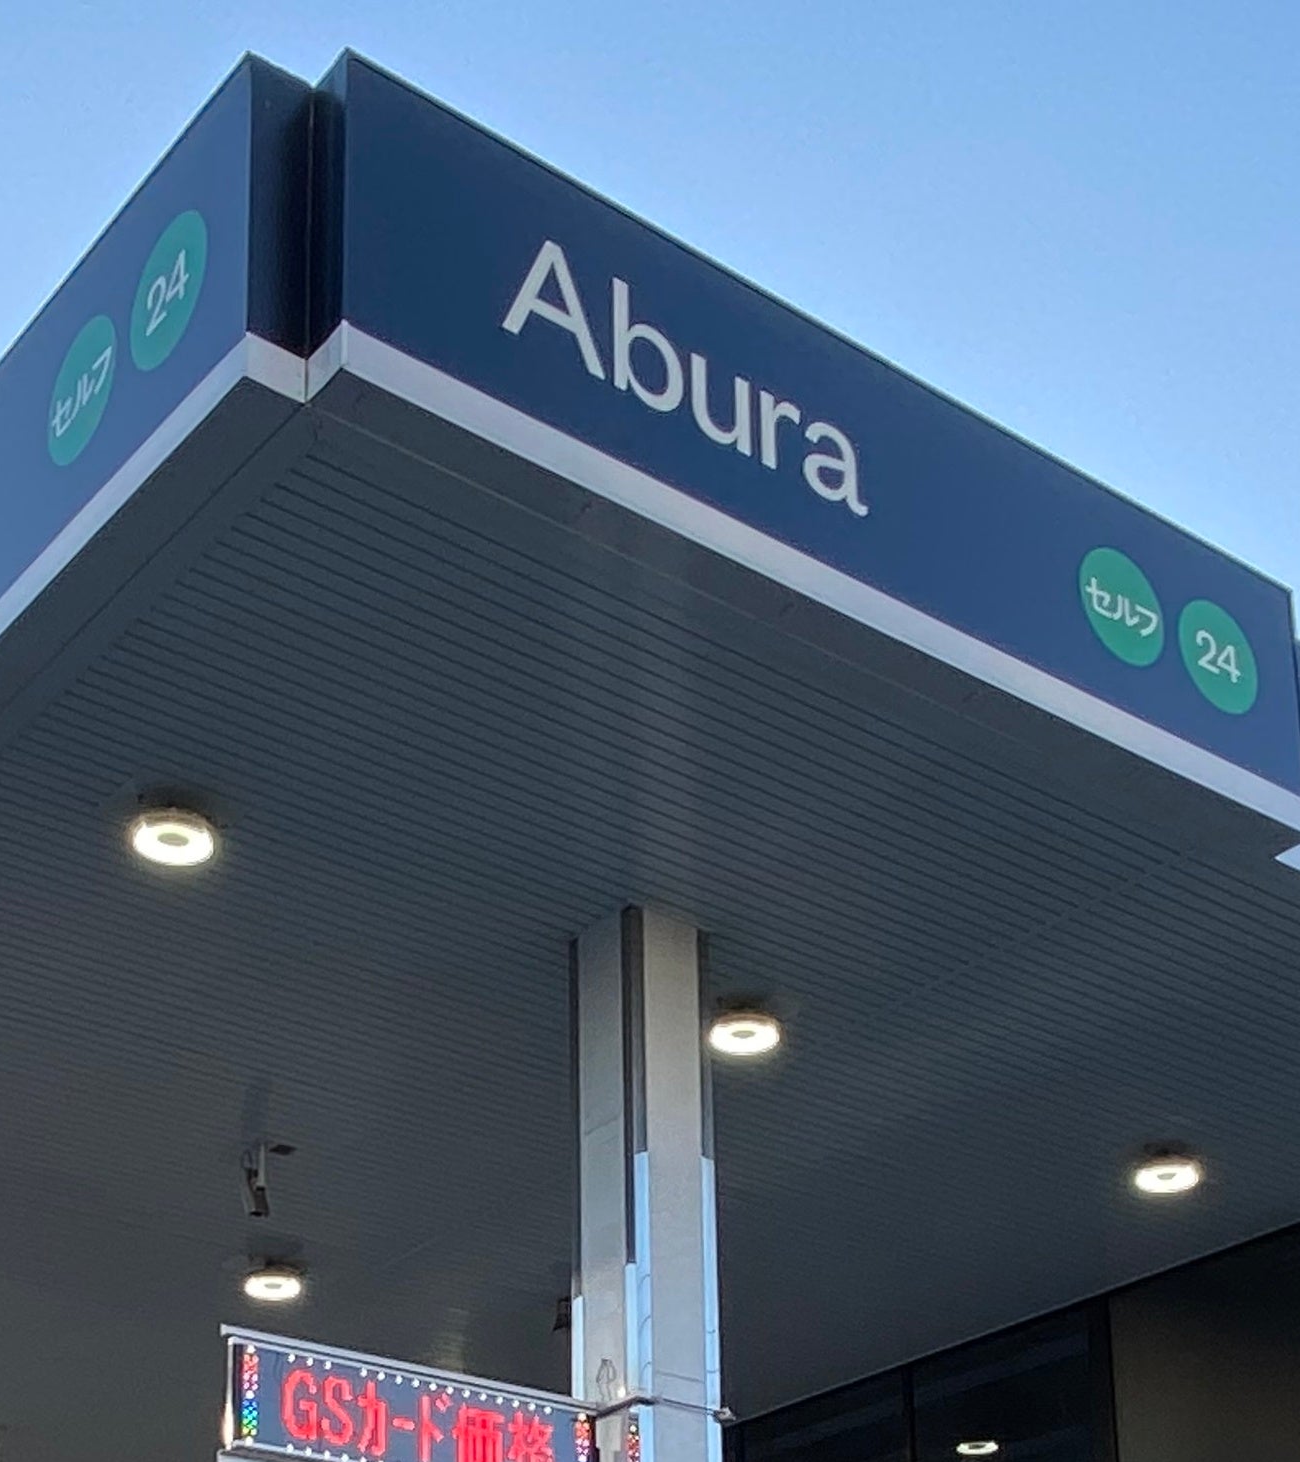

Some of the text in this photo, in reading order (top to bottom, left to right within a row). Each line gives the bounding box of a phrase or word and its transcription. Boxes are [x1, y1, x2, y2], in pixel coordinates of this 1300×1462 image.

[146, 249, 190, 336] 24
[51, 346, 112, 437] セルフ
[502, 240, 868, 517] Abura
[1085, 577, 1158, 637] セルフ
[1196, 630, 1241, 683] 24
